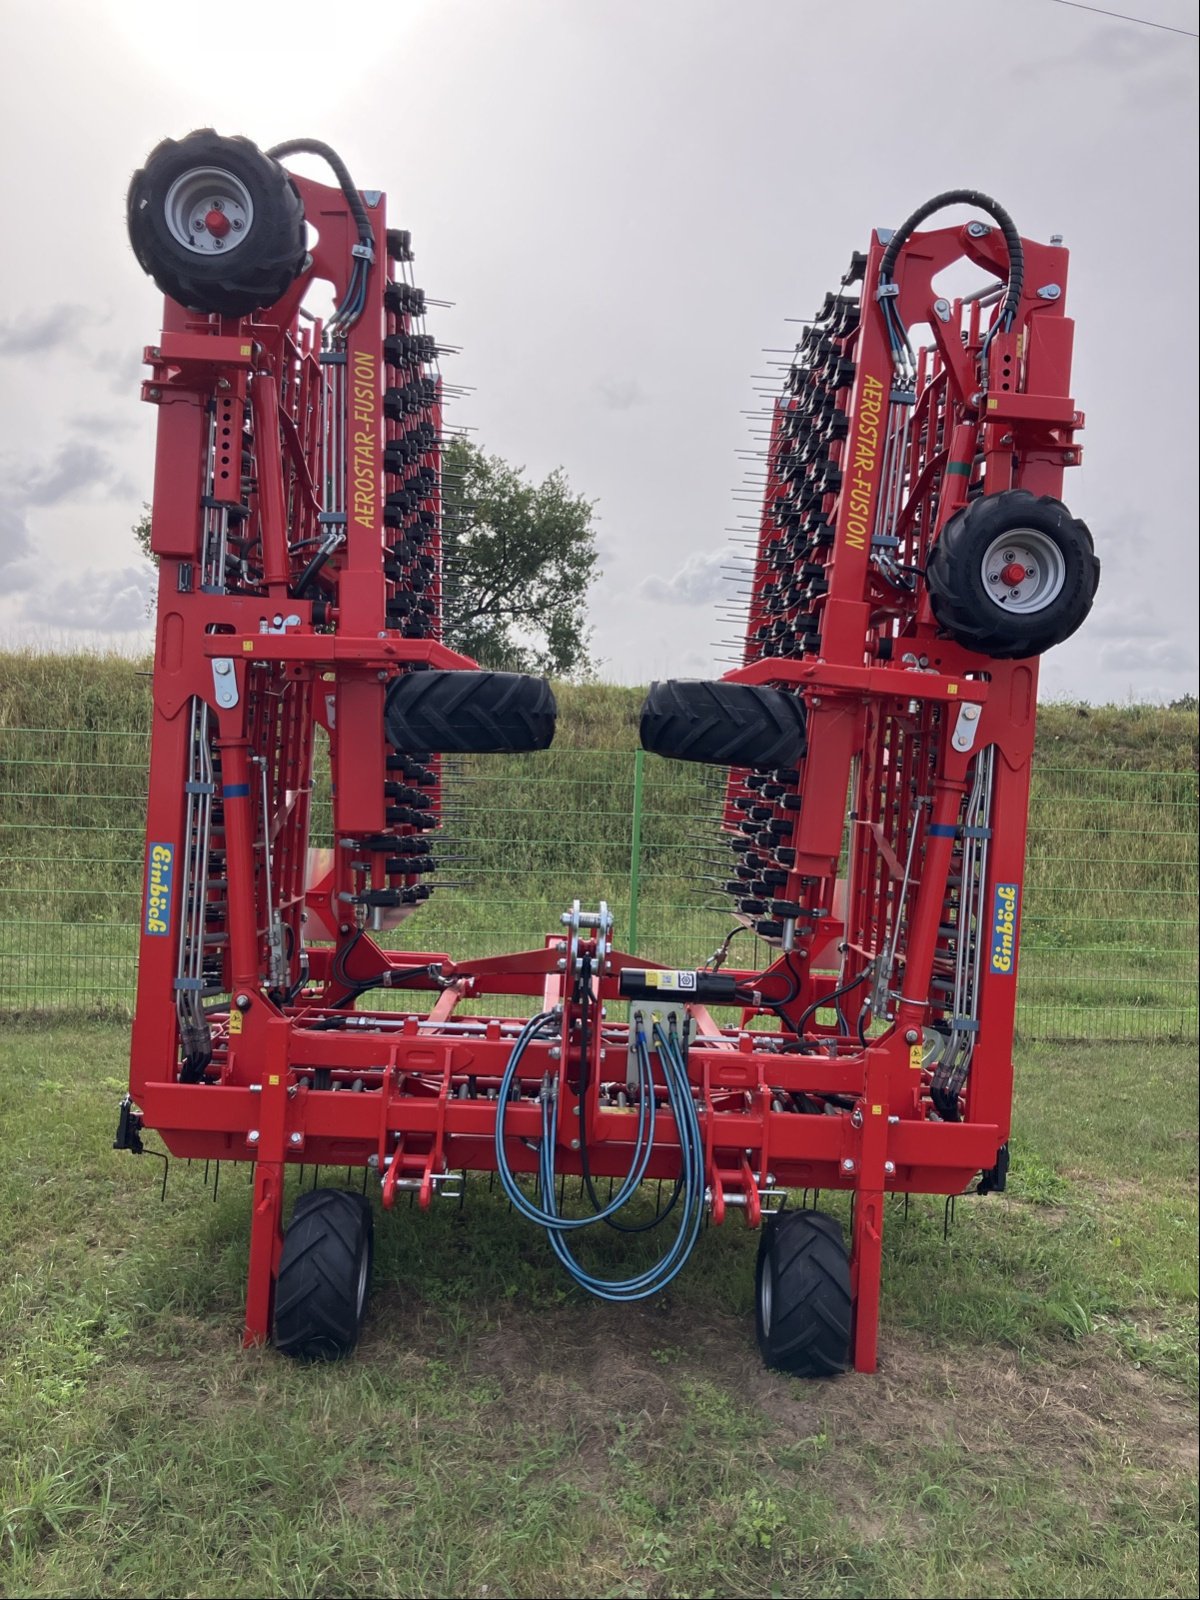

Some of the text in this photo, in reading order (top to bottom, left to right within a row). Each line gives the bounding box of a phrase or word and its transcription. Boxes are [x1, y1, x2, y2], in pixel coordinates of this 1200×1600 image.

[354, 351, 375, 529] AEROSTAR-FUSION
[845, 374, 884, 550] AEROSTAR-FUSION
[148, 845, 172, 933] Einböck
[992, 886, 1016, 972] Einböck
